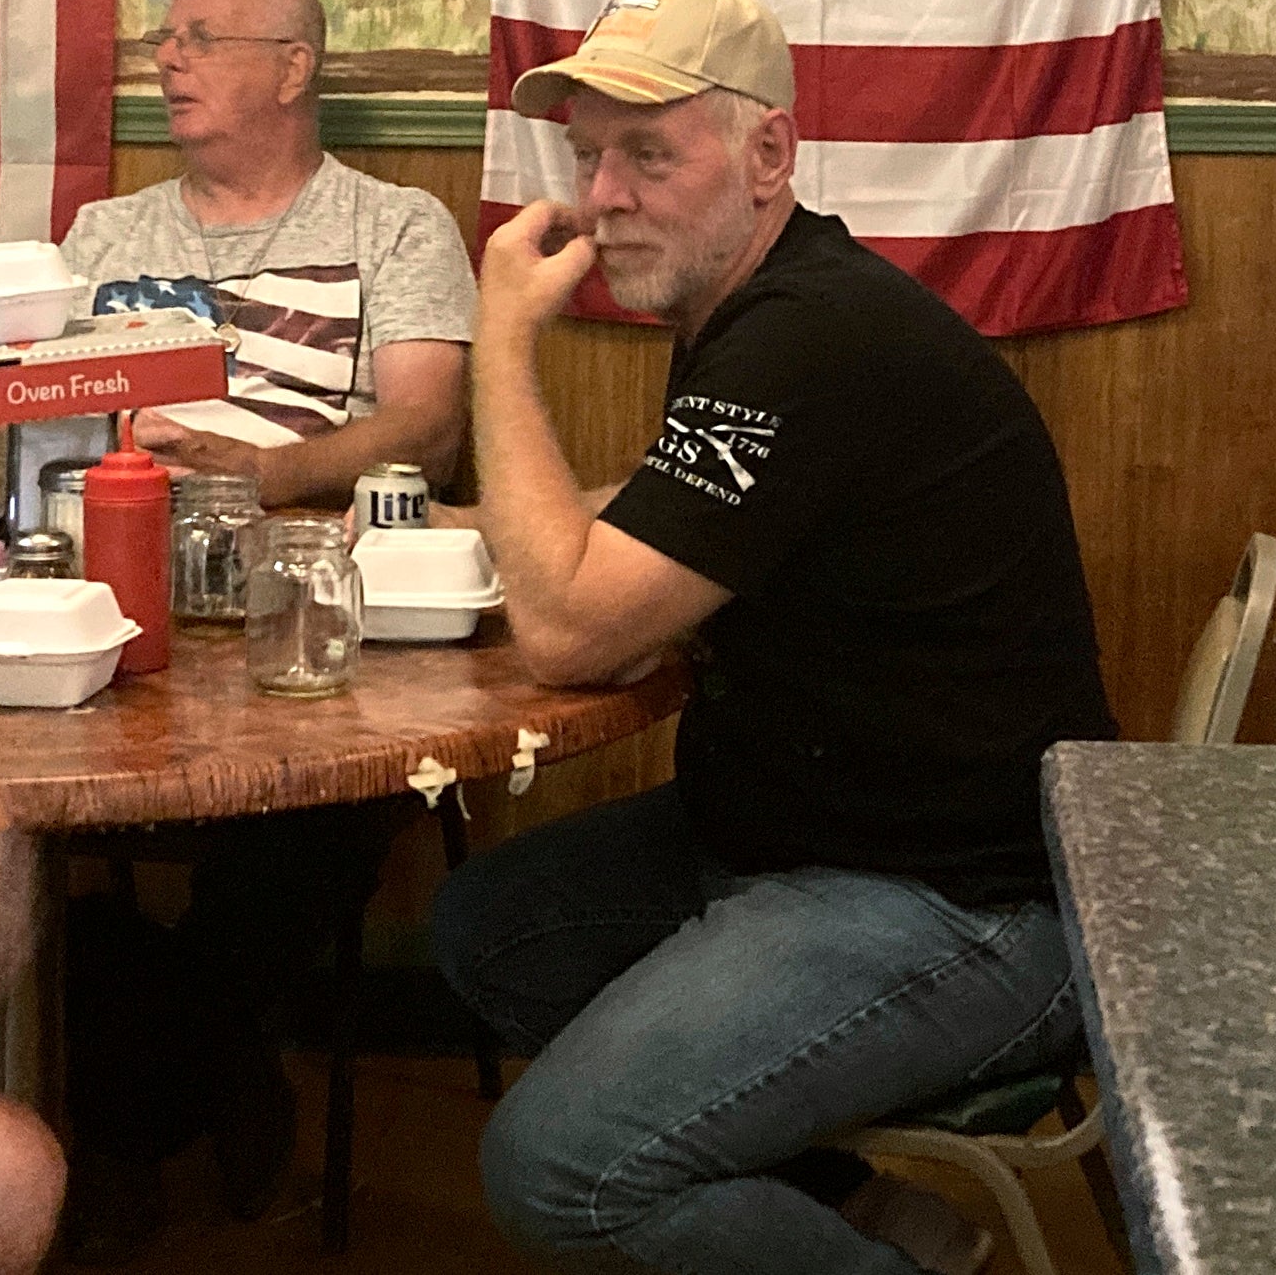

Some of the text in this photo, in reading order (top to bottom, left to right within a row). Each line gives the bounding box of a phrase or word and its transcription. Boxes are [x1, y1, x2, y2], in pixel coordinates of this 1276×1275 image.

[6, 370, 131, 405] Oven Fresh
[673, 466, 742, 506] DEFEND
[368, 489, 426, 529] Lite
